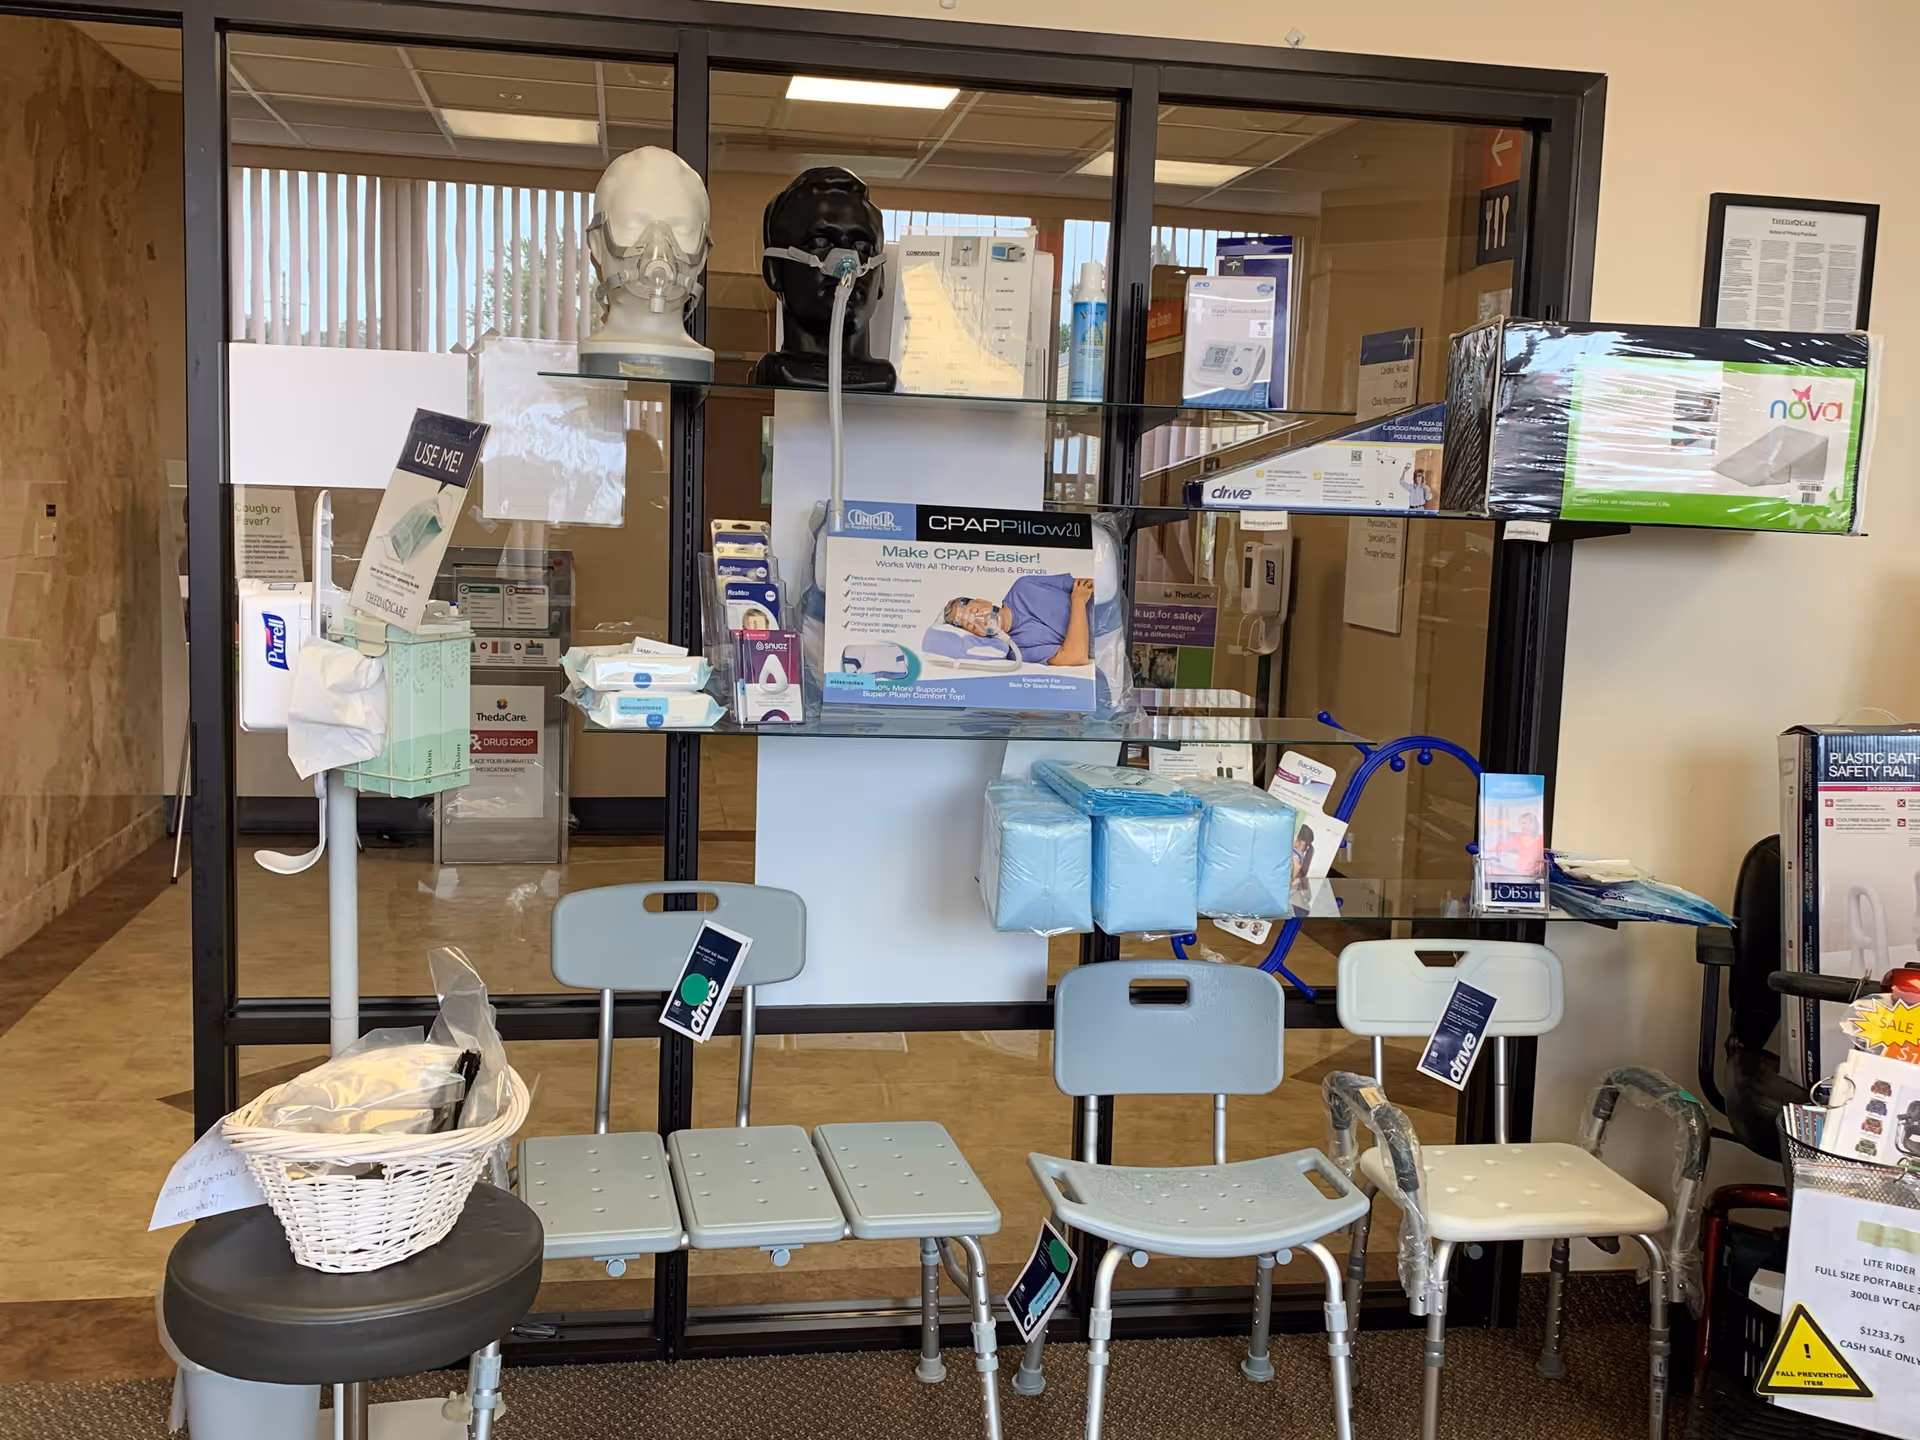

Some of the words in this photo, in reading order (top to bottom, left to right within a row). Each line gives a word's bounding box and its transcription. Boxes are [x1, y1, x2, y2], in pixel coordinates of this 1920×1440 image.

[1769, 397, 1842, 422] nova
[414, 441, 440, 467] USE
[438, 449, 464, 473] ME!
[1211, 485, 1252, 500] drive
[235, 502, 268, 515] Cough
[271, 506, 282, 514] or
[1619, 499, 1657, 507] Independent
[848, 509, 895, 527] CONTOUR
[882, 545, 929, 559] Make
[934, 548, 980, 561] CPAP
[985, 550, 1040, 564] Easier!
[875, 560, 905, 569] Works
[906, 561, 926, 570] With
[927, 562, 938, 570] All
[940, 563, 975, 574] Therapy
[976, 565, 1006, 574] Masks
[1008, 566, 1015, 574] &
[1016, 567, 1047, 575] Brands
[1143, 611, 1155, 620] up
[1157, 610, 1171, 619] for
[1173, 612, 1203, 623] safety
[267, 618, 284, 664] Purell
[1150, 631, 1186, 639] difference!
[862, 690, 886, 698] Super
[889, 691, 911, 699] Plush
[913, 692, 946, 700] Comfort
[948, 693, 966, 701] Top!
[892, 684, 914, 692] More
[916, 685, 948, 694] Support
[476, 712, 528, 722] ThedaCare
[483, 738, 509, 747] DRUG
[510, 738, 534, 747] DROP
[1829, 752, 1885, 764] PLASTIC
[1828, 765, 1880, 777] SAFETY
[1882, 765, 1916, 778] RAIL,
[1494, 884, 1534, 901] JOBST
[1878, 1016, 1915, 1035] SALE
[1449, 1032, 1477, 1082] drive
[1863, 1257, 1884, 1269] LITE
[1886, 1262, 1916, 1276] RIDER
[1814, 1265, 1838, 1278] FULL
[1840, 1271, 1861, 1282] SIZE
[1863, 1275, 1916, 1294] PORTABLE
[1850, 1290, 1880, 1303] 300LB
[1882, 1296, 1899, 1307] WT
[1859, 1326, 1905, 1344] $1233.75
[1839, 1339, 1866, 1352] CASH
[1869, 1346, 1893, 1359] SALE
[1797, 1371, 1849, 1379] PREVENTION
[1803, 1379, 1824, 1387] ITEM
